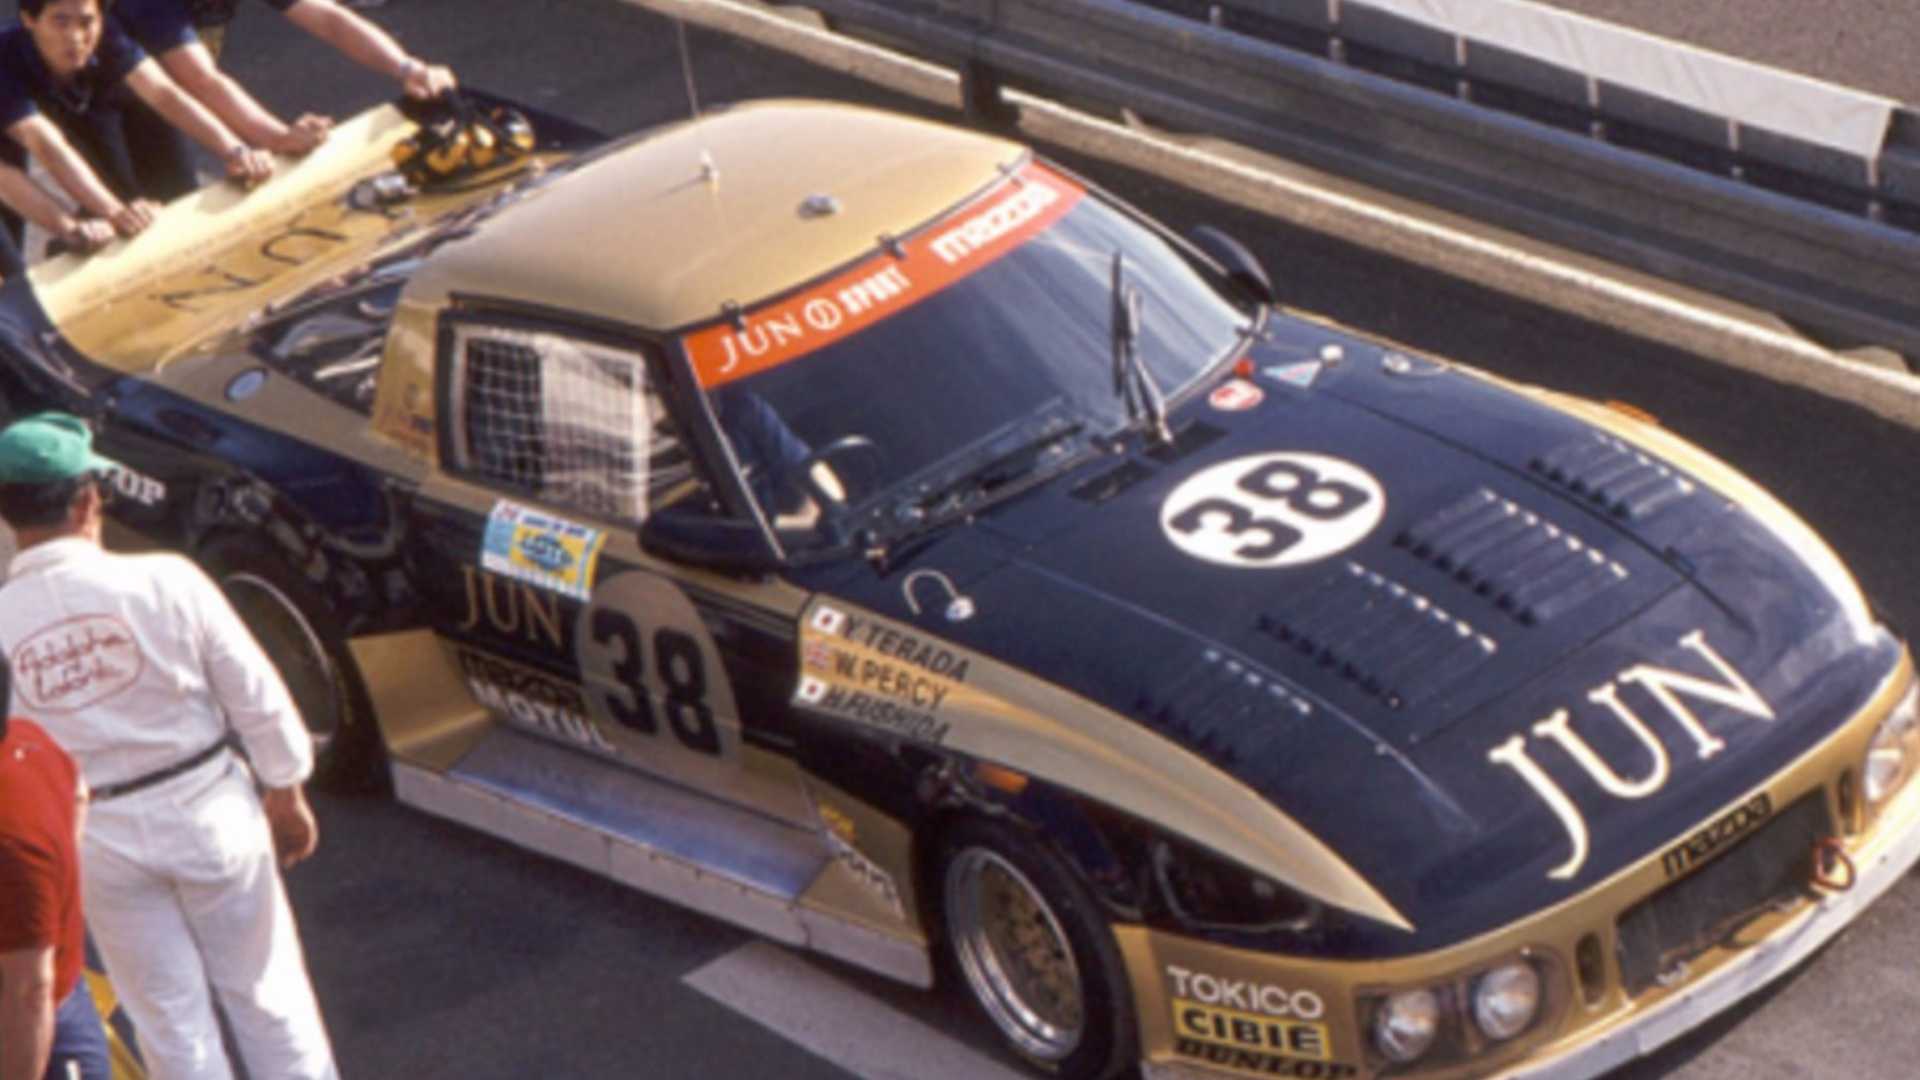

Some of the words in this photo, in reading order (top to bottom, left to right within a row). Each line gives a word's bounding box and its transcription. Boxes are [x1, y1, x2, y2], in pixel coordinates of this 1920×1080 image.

[719, 312, 804, 374] JUN
[1168, 459, 1372, 561] 38
[457, 563, 565, 650] JUN
[591, 606, 723, 757] 38
[1488, 629, 1776, 880] JUN
[1166, 964, 1325, 1020] TOKICO
[1174, 1037, 1359, 1080] DUNLOP
